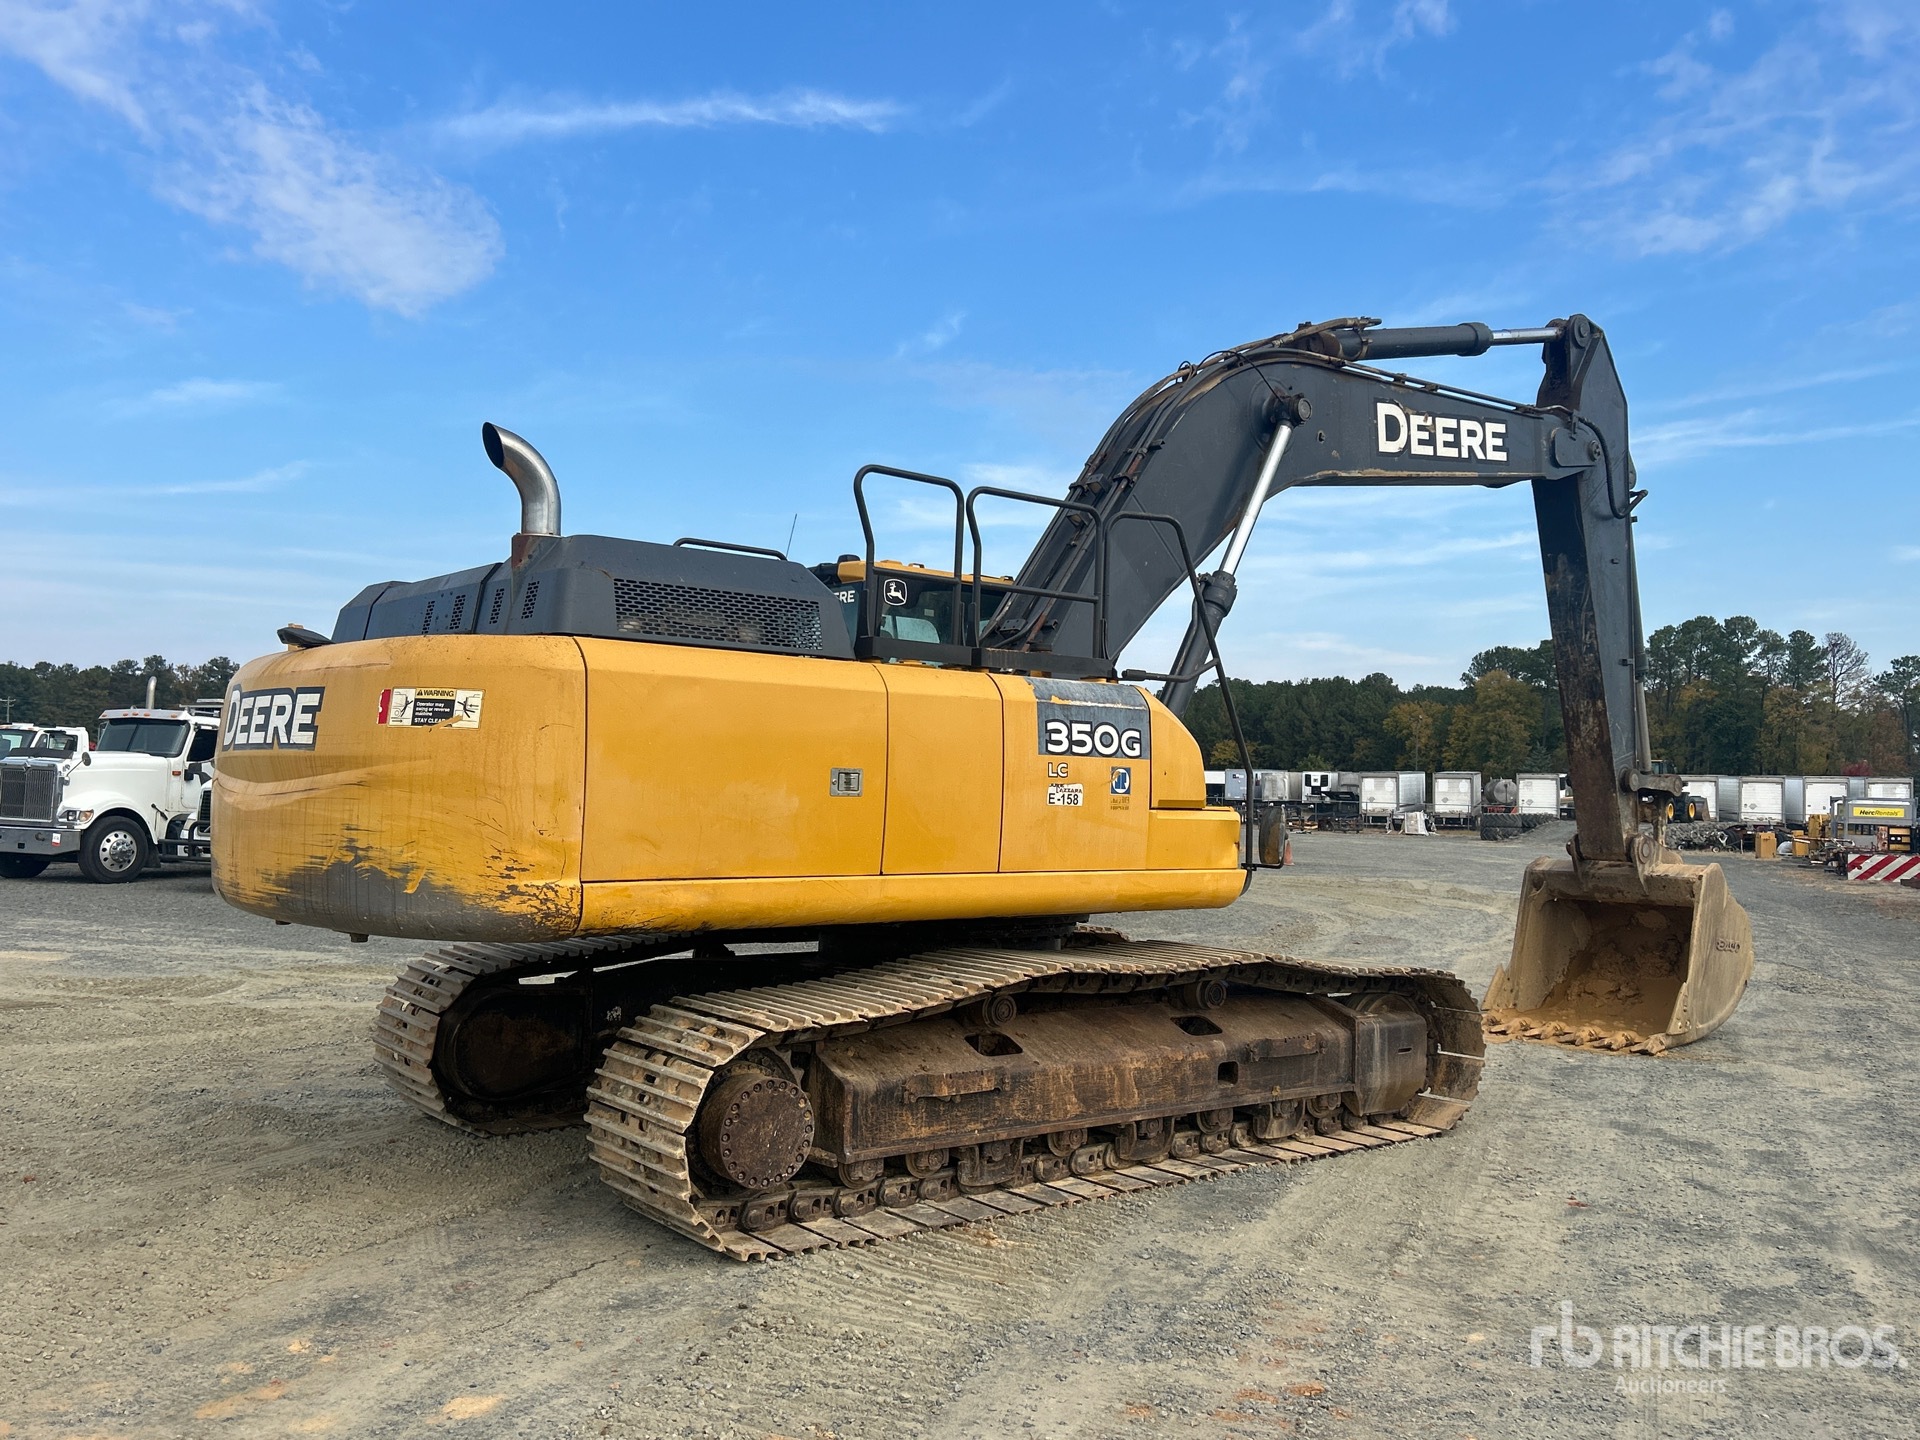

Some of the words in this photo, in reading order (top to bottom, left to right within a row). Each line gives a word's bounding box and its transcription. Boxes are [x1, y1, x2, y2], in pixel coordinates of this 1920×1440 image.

[1376, 402, 1508, 462] DEERE
[223, 690, 321, 746] DEERE
[1046, 720, 1141, 757] 350G
[1048, 762, 1068, 778] LC
